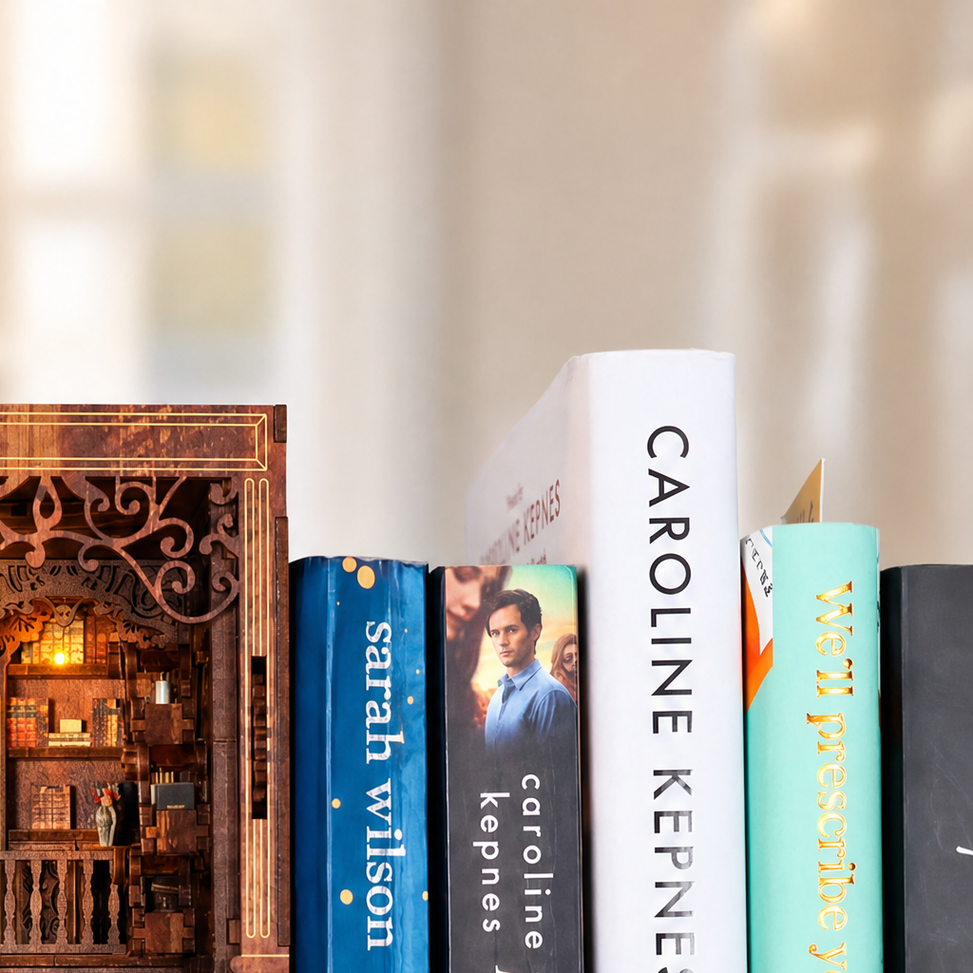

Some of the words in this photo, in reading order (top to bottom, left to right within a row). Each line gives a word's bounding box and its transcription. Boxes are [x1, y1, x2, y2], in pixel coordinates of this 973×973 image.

[523, 479, 561, 546] KEPNES
[646, 424, 694, 735] CAROLINE
[365, 621, 405, 765] sarah
[365, 778, 407, 952] wilson
[473, 792, 510, 933] kepnes
[521, 774, 554, 949] caroline
[806, 713, 856, 932] prescribe
